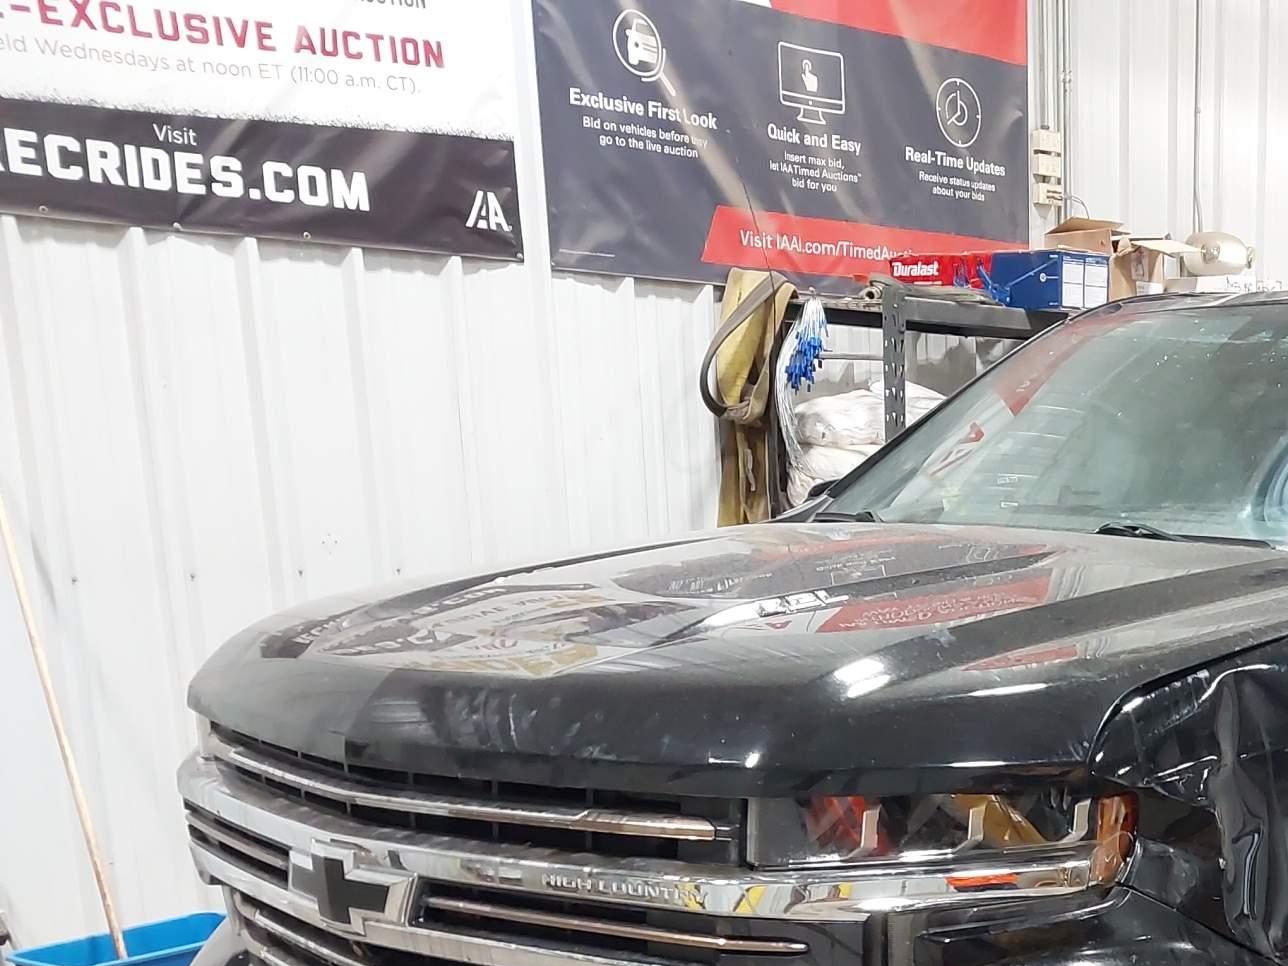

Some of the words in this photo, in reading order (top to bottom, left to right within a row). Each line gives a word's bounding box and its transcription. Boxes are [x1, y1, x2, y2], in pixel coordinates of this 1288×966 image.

[0, 0, 276, 52] -EXCLUSIVE
[294, 25, 445, 68] AUCTION
[0, 33, 27, 54] ld
[34, 37, 171, 72] Wednesdays
[176, 57, 196, 73] at
[202, 60, 251, 78] noon
[258, 63, 283, 80] ET
[290, 65, 339, 84] (11:00
[345, 74, 382, 89] a.m.
[386, 75, 422, 94] CT).
[569, 87, 645, 116] Exclusive
[647, 100, 682, 124] First
[682, 108, 718, 130] Look
[153, 123, 198, 146] Visit
[582, 115, 601, 129] Bid
[603, 122, 617, 132] on
[619, 122, 657, 138] vehicles
[658, 128, 690, 143] before
[767, 123, 801, 144] Quick
[803, 133, 828, 148] and
[831, 134, 862, 156] Easy
[599, 135, 613, 147] go
[615, 136, 626, 147] to
[628, 136, 644, 149] the
[646, 139, 662, 153] live
[663, 144, 699, 159] auction
[0, 127, 371, 211] ECRIDES.COM
[769, 160, 780, 171] let
[784, 150, 806, 163] Insert
[808, 156, 826, 167] max
[828, 157, 845, 170] bid,
[905, 146, 964, 169] Real-Time
[966, 156, 1006, 177] Updates
[791, 177, 805, 188] bid
[806, 178, 820, 190] for
[821, 183, 837, 193] you
[919, 171, 948, 184] Receive
[949, 176, 970, 188] status
[970, 180, 996, 192] updates
[932, 185, 954, 197] about
[955, 190, 971, 201] your
[971, 190, 985, 202] bids
[740, 229, 773, 249] Visit
[891, 260, 940, 278] Duralast
[542, 873, 592, 891] HIGH
